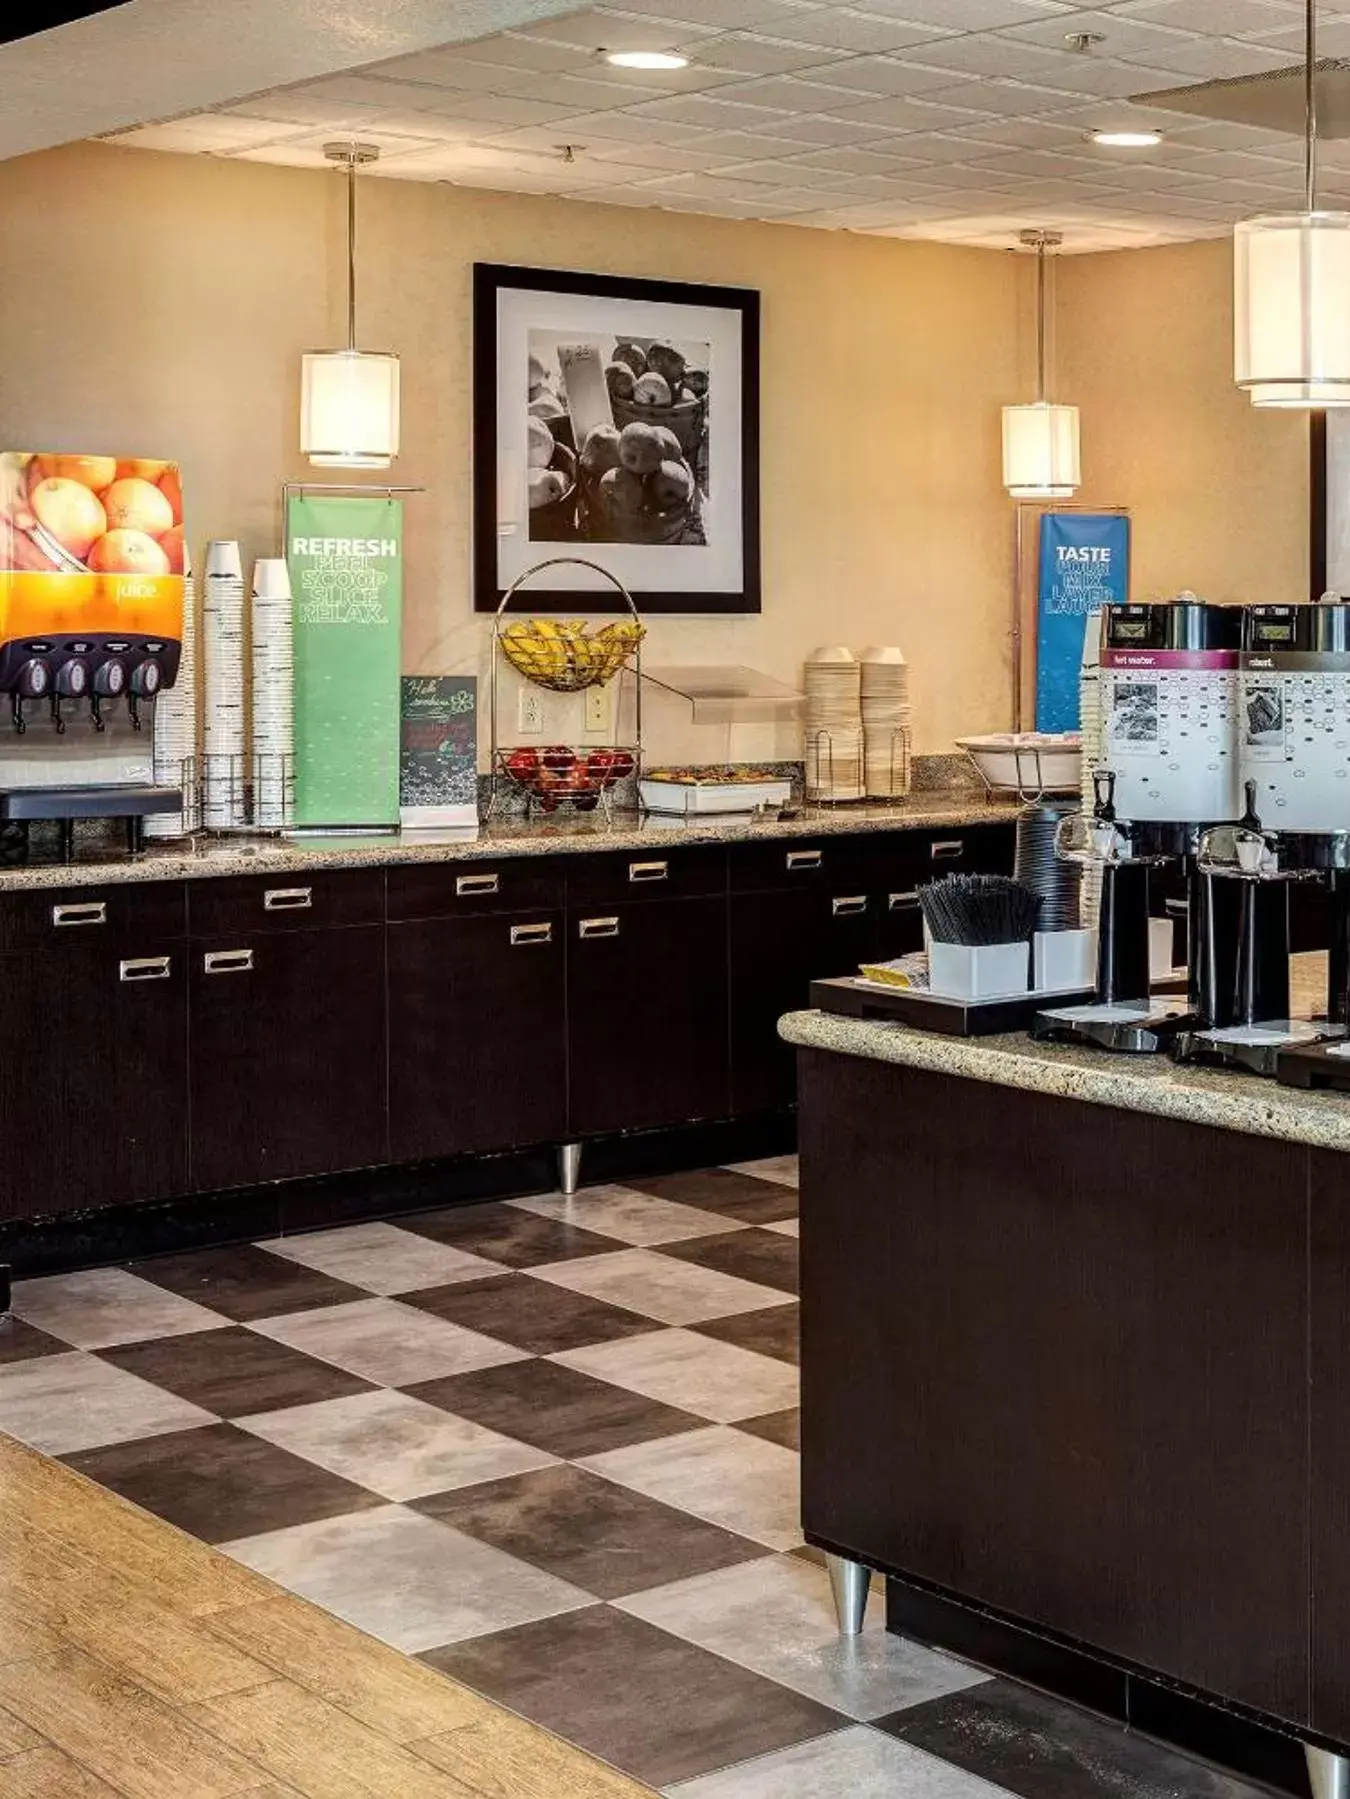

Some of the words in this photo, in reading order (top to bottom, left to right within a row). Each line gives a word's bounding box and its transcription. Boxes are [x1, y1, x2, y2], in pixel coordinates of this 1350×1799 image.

[293, 537, 397, 557] REFRESH
[1056, 546, 1111, 561] TASTE
[302, 569, 388, 590] SCOOP
[311, 587, 379, 606] SLICE
